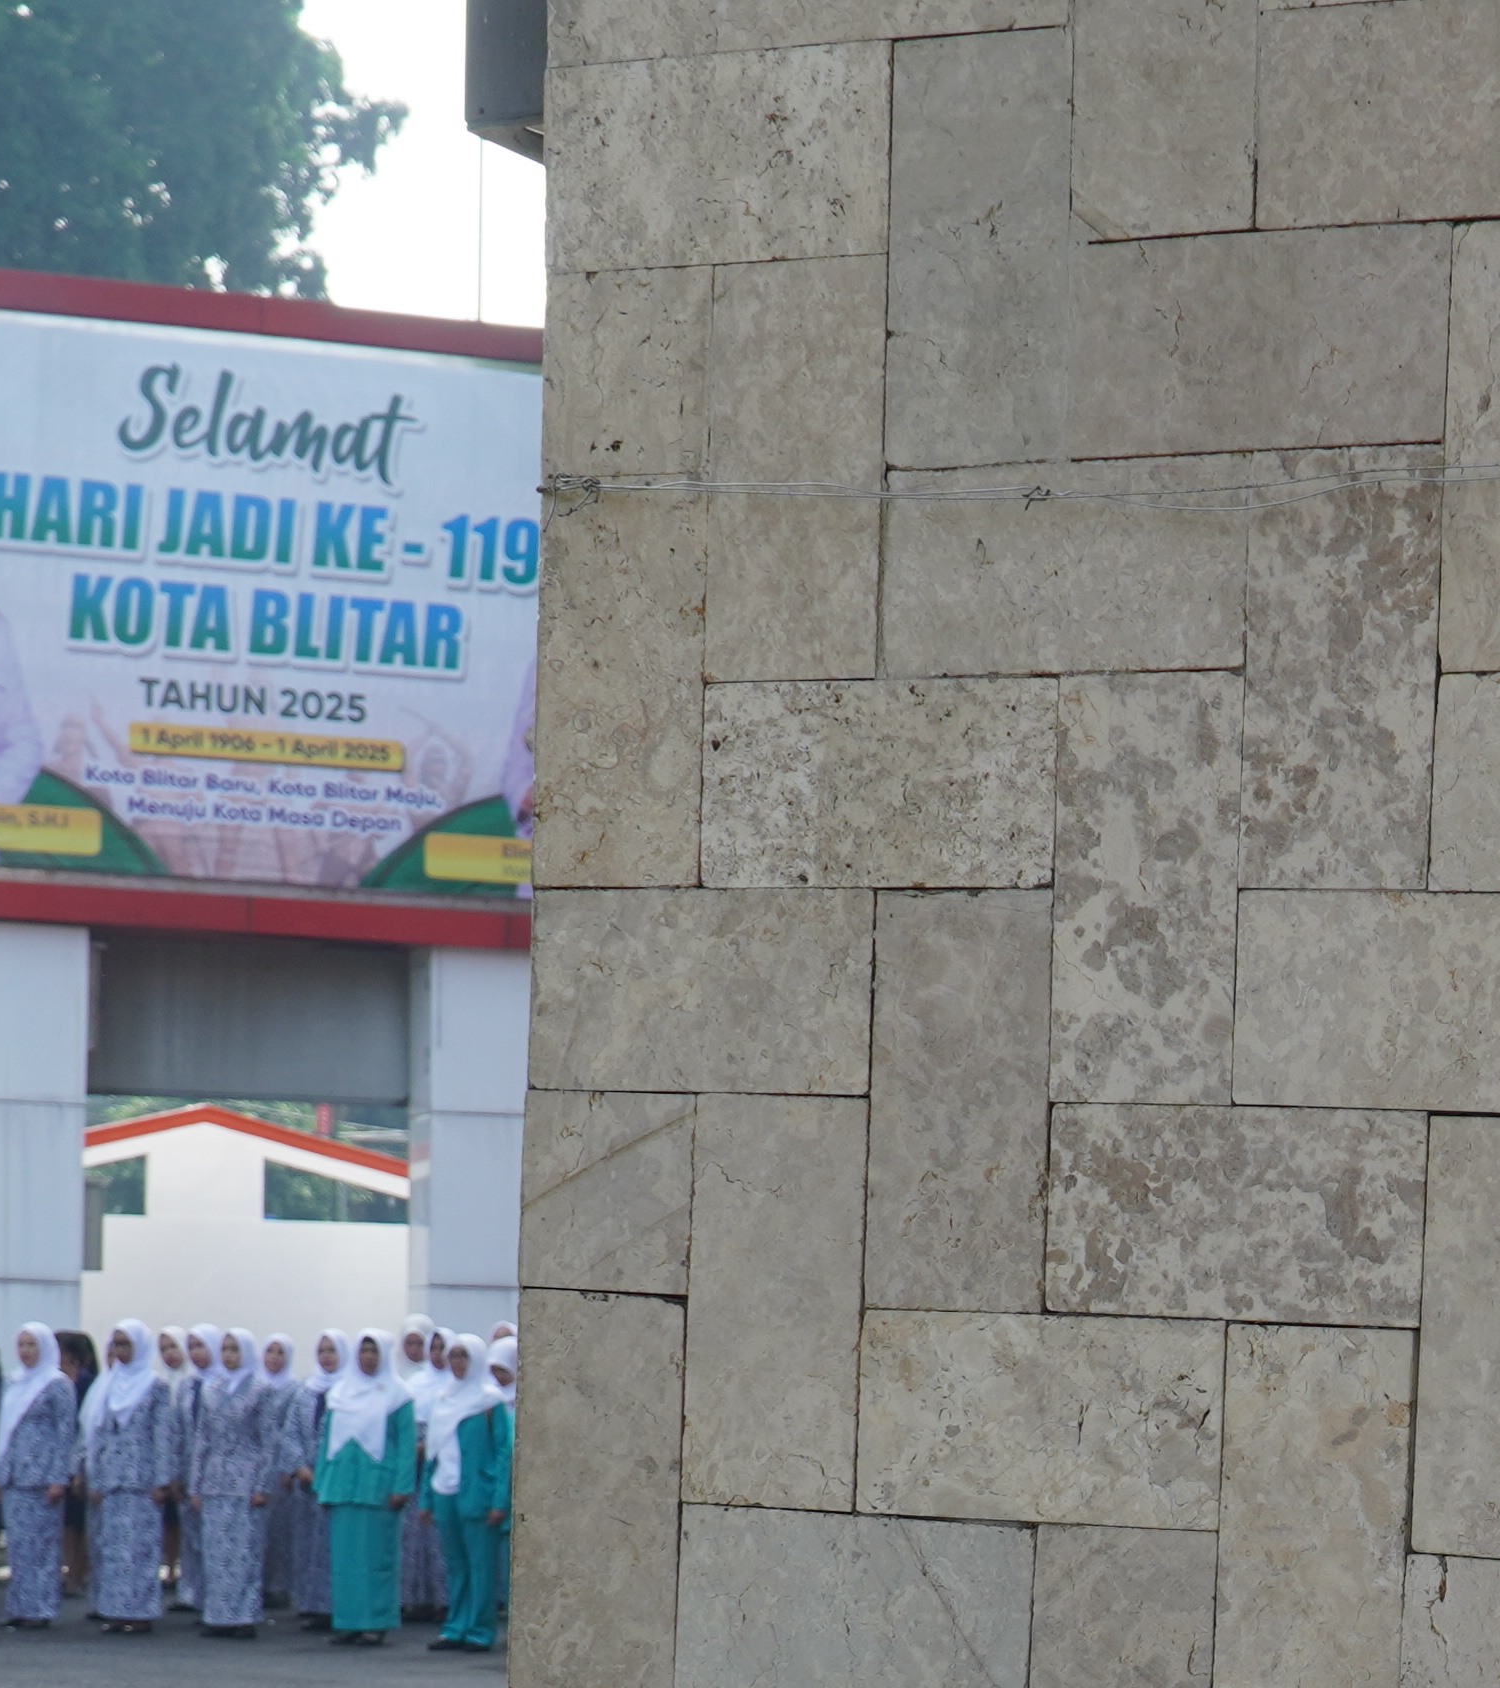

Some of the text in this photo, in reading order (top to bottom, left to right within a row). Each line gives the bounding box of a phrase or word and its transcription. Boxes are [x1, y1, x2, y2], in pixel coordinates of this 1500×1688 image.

[118, 362, 419, 487] Selamat
[159, 487, 296, 564] JADI
[312, 501, 390, 573] KE
[442, 514, 541, 586] 119
[68, 573, 465, 671] KOTA BLITAR
[139, 677, 368, 724] TAHUN 2025
[141, 728, 149, 745] 1
[156, 728, 204, 750] April
[211, 731, 256, 752] 1906
[278, 737, 285, 754] 1
[292, 738, 339, 759] April
[344, 743, 391, 762] 2025
[85, 765, 135, 785] Kota
[142, 769, 198, 789] Blitar
[205, 773, 261, 795] Baru,
[269, 778, 317, 798] Kota
[323, 782, 379, 802] Blitar
[127, 798, 403, 832] Menuju Kota Masa Depan
